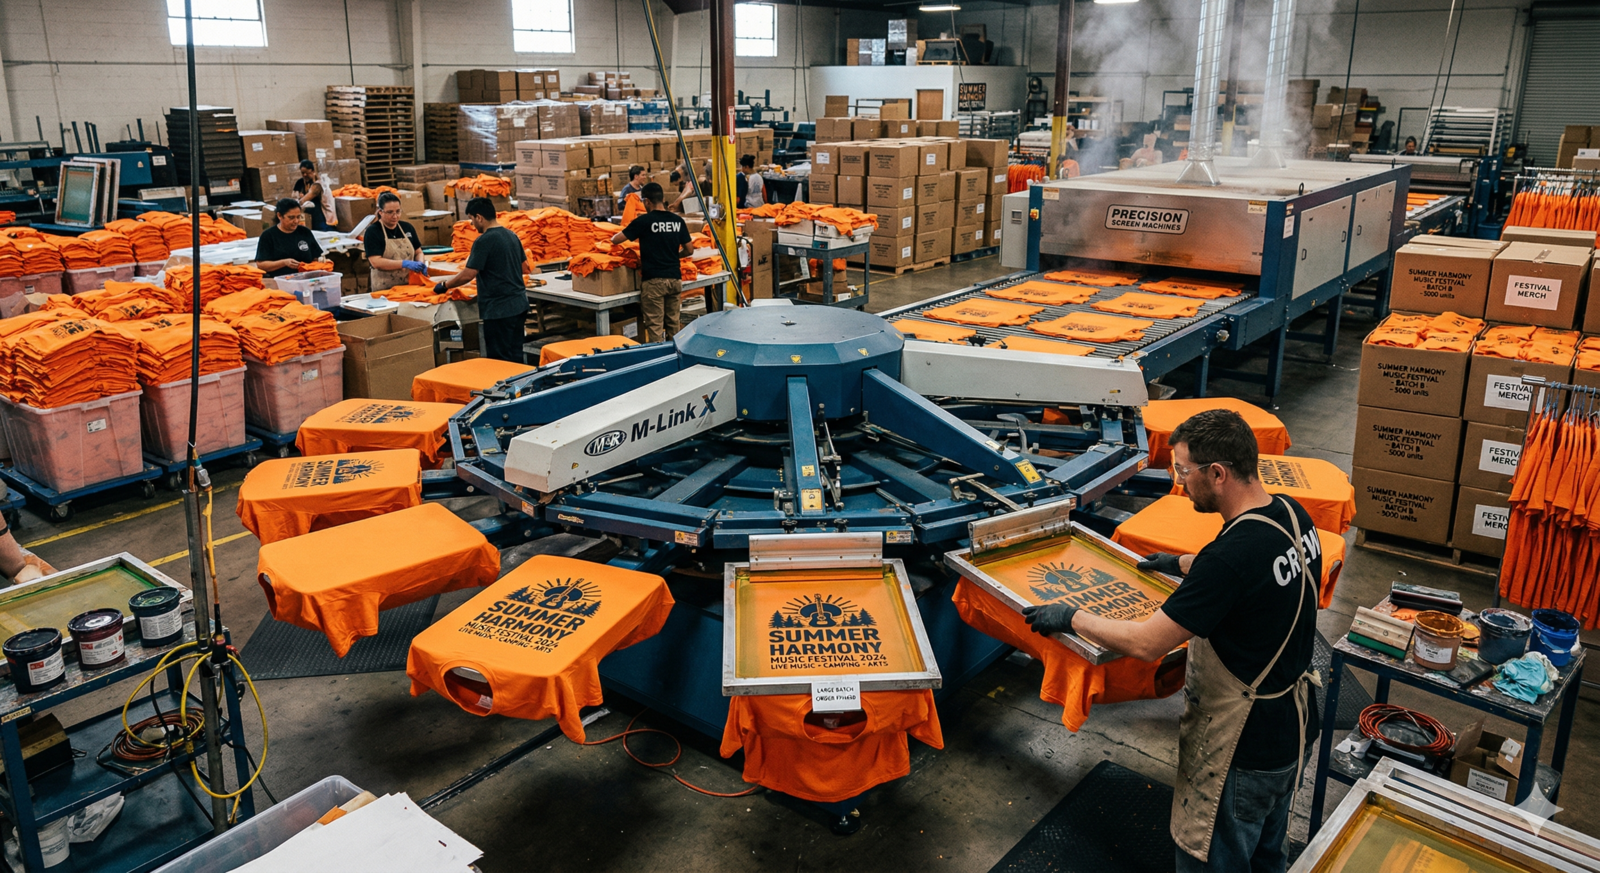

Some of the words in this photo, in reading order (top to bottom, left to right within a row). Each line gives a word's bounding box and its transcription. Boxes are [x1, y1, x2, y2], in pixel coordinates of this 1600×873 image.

[1111, 209, 1183, 223] PRECISION
[651, 221, 682, 233] CREW
[1111, 219, 1141, 228] SCREEN
[1141, 222, 1181, 231] MACHINES
[1408, 269, 1437, 277] SUMMER
[1435, 278, 1466, 286] FESTIVAL
[1514, 282, 1552, 292] FESTIVAL
[1518, 290, 1547, 299] MERCH
[1377, 363, 1408, 372] SUMMER
[1410, 366, 1446, 376] HARMONY
[1383, 371, 1406, 379] MUSIC
[1406, 374, 1439, 383] FESTIVAL
[1396, 380, 1418, 388] BATCH
[1498, 391, 1530, 401] MERCH
[630, 402, 697, 442] M-Link
[698, 390, 719, 418] X
[1372, 424, 1404, 434] SUMMER
[1404, 429, 1442, 440] HARMONY
[1378, 433, 1400, 442] MUSIC
[1402, 436, 1435, 447] FESTIVAL
[1391, 442, 1414, 451] BATCH
[1489, 447, 1520, 458] FESTIV
[1366, 486, 1397, 496] SUMMER
[1398, 492, 1434, 504] HARMONY
[1372, 494, 1394, 504] MUSIC
[1394, 498, 1427, 510] FESTIVAL
[1384, 504, 1408, 513] BATCH
[1482, 512, 1508, 522] FESTIV
[1484, 520, 1508, 530] MERC
[1058, 582, 1138, 609] UMMER
[1087, 590, 1150, 616] RMONY
[488, 600, 586, 631] SUMMER
[464, 621, 495, 633] MUSIC
[496, 628, 534, 643] FESTIVAL
[473, 612, 574, 640] HARMONY
[769, 628, 881, 643] SUMMER
[770, 642, 882, 656] HARMONY
[770, 656, 806, 664] MUSIC
[808, 654, 858, 663] FESTIVAL
[860, 654, 887, 662] 2024
